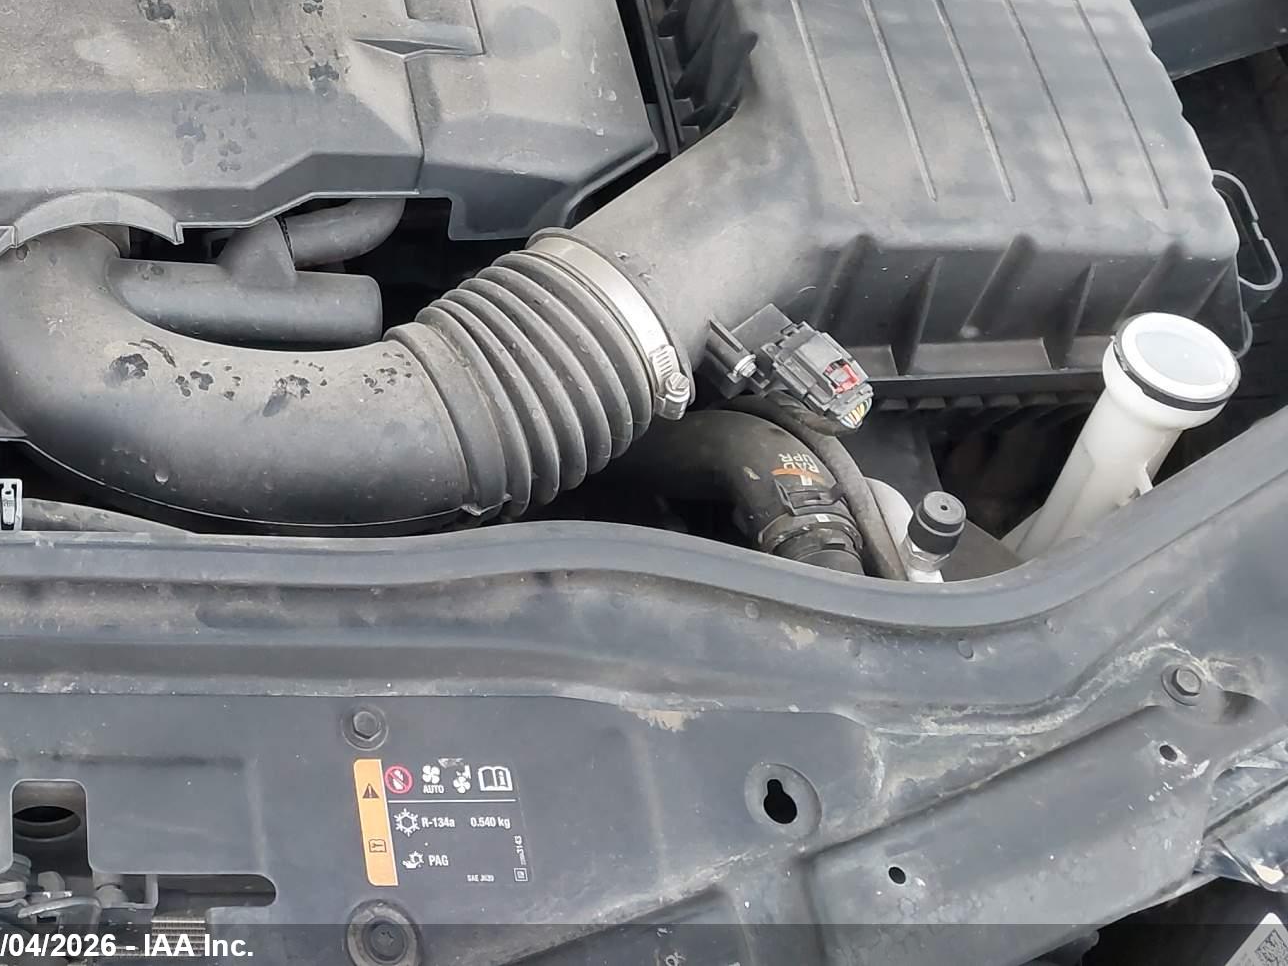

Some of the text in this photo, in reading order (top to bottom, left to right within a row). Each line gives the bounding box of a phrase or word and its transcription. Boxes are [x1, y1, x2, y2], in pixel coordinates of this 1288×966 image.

[423, 785, 445, 794] AUTO
[421, 817, 511, 830] R-134a 0.540 kg
[428, 855, 449, 867] PAG
